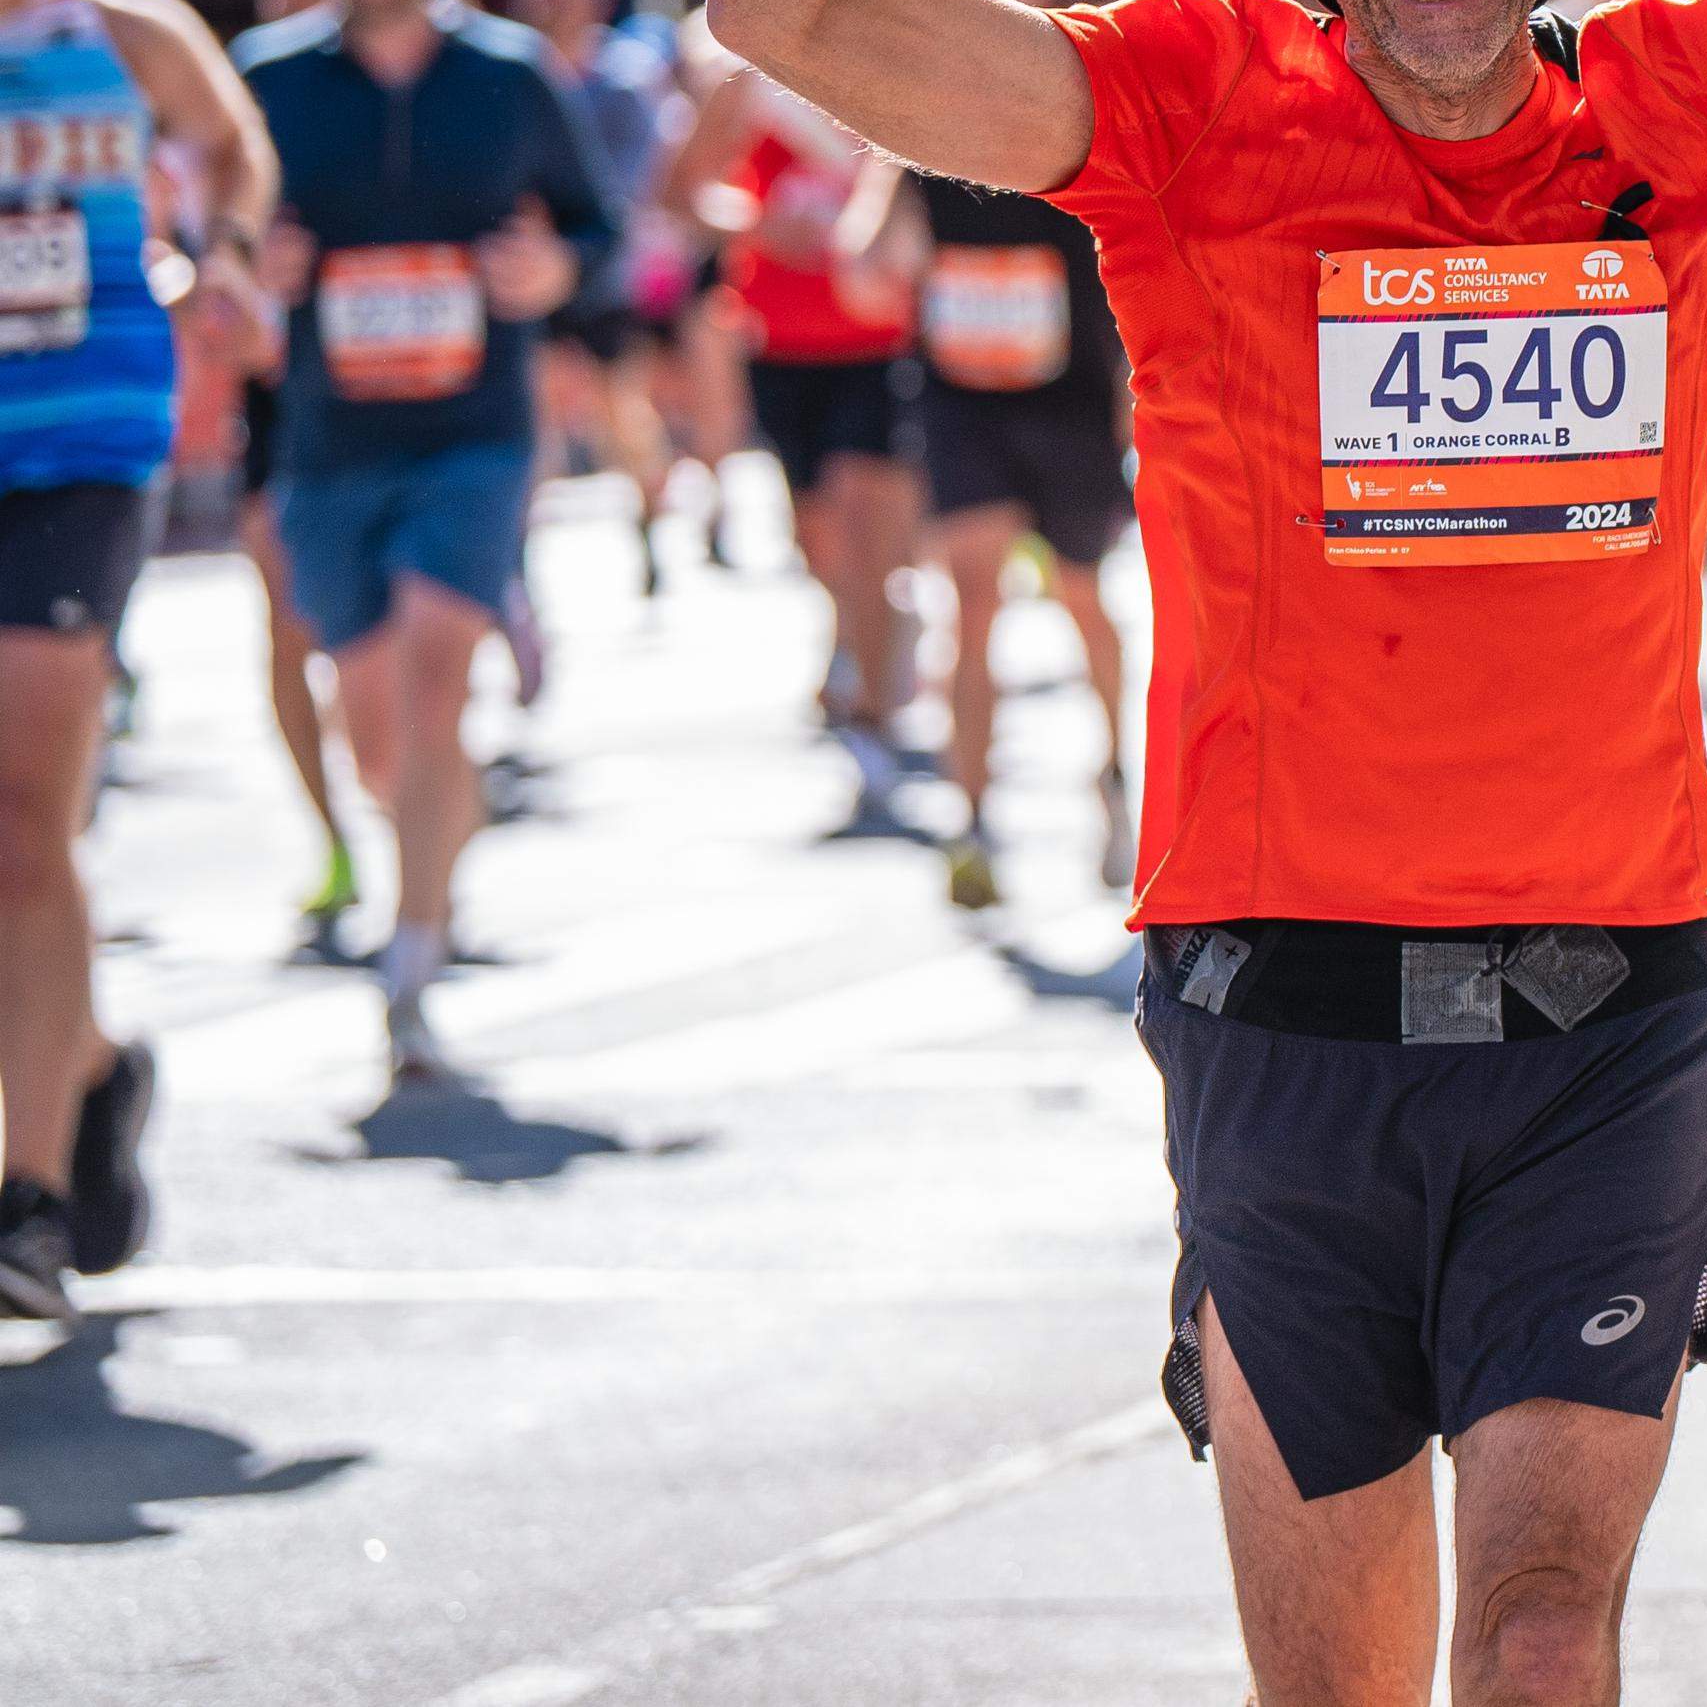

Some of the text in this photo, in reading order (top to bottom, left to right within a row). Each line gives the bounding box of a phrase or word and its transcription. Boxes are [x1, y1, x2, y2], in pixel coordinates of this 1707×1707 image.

[1444, 257, 1488, 272] TATA
[1363, 260, 1436, 306] tcs
[1444, 272, 1547, 287] CONSULTANCY
[1444, 289, 1509, 304] SERVICES
[1575, 282, 1630, 300] TATA
[1369, 324, 1626, 424] 4540
[1334, 427, 1571, 452] WAVE 1 ORANGE CORRAL B
[1363, 516, 1508, 532] #TCSNYCMarathon
[1566, 502, 1632, 530] 2024
